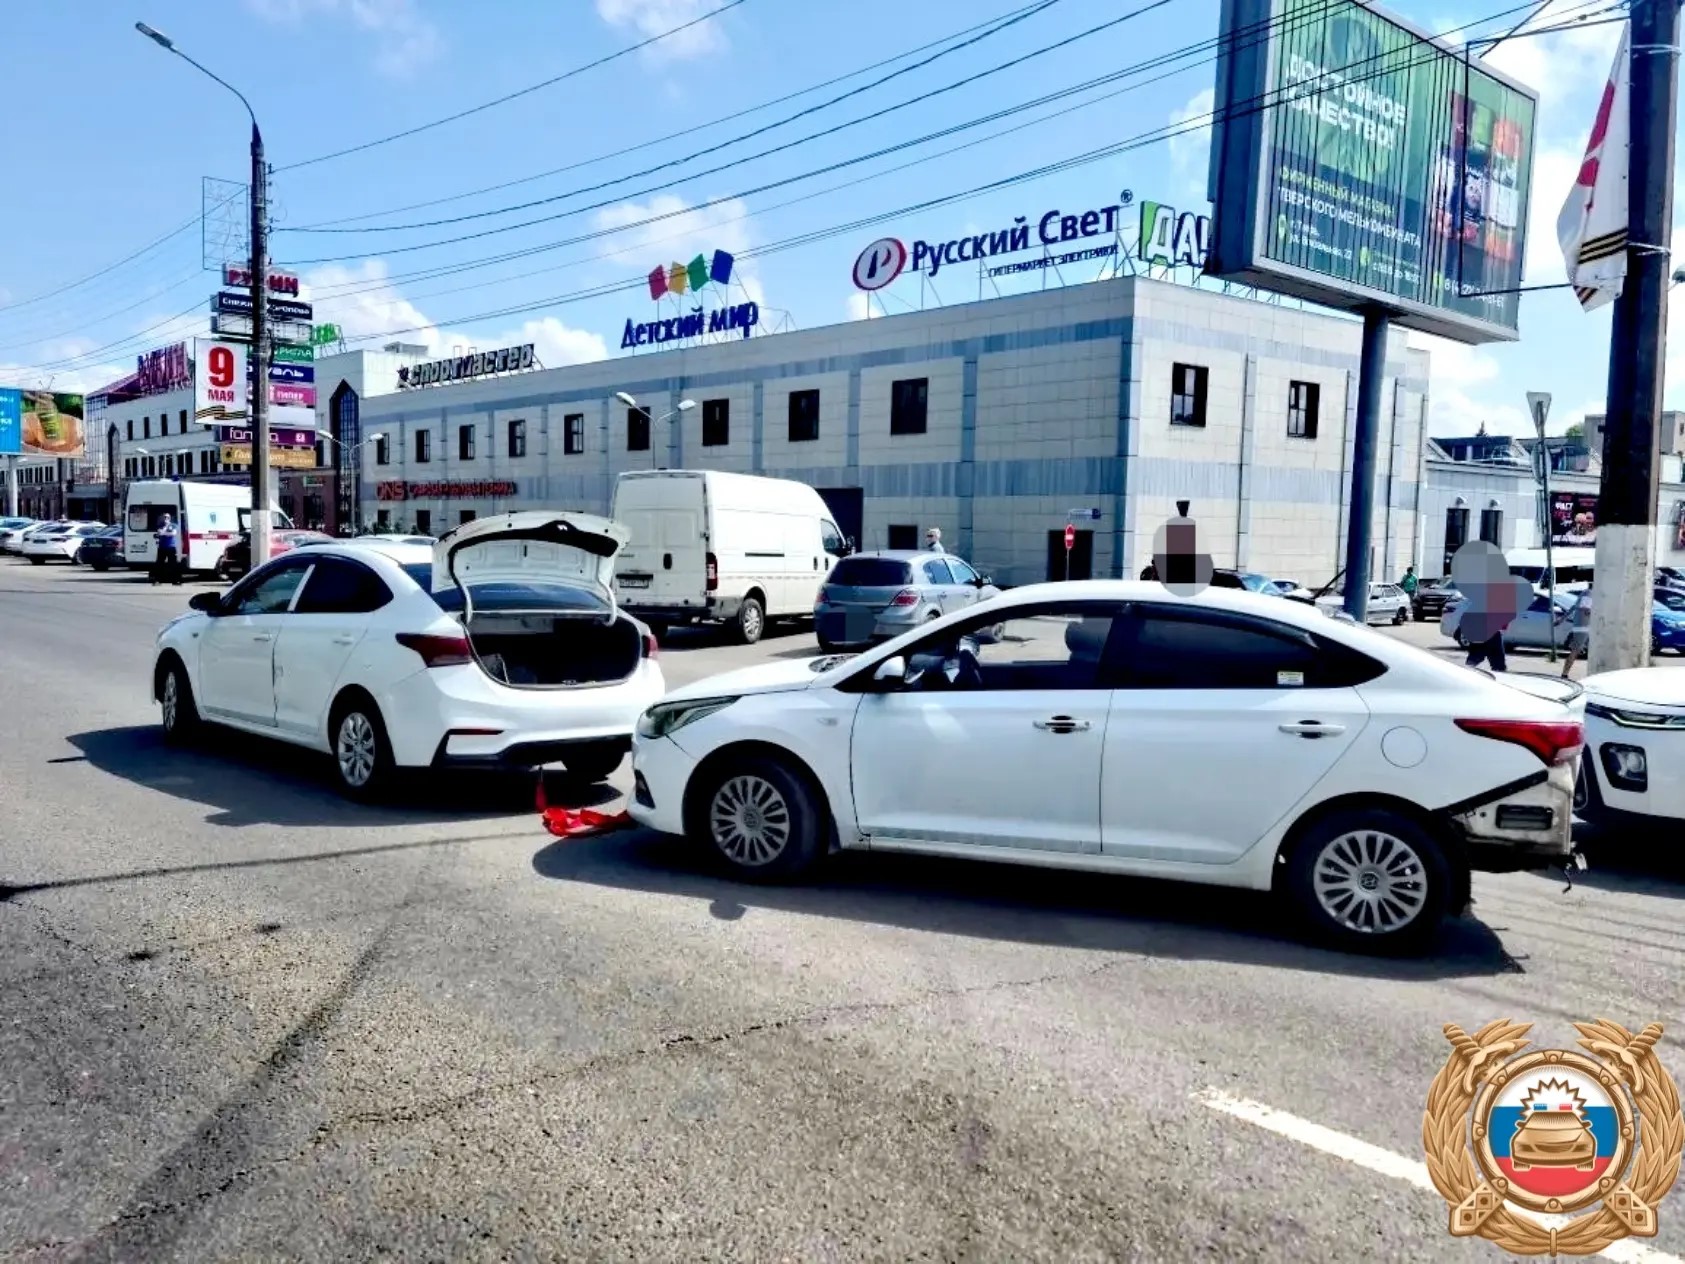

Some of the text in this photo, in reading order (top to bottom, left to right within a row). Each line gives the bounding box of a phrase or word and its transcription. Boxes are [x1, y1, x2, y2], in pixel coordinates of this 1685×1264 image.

[912, 216, 1030, 277] Русский
[1039, 205, 1120, 245] Свет
[620, 301, 759, 349] Детский мир
[209, 346, 234, 387] 9
[208, 389, 234, 402] МАЯ
